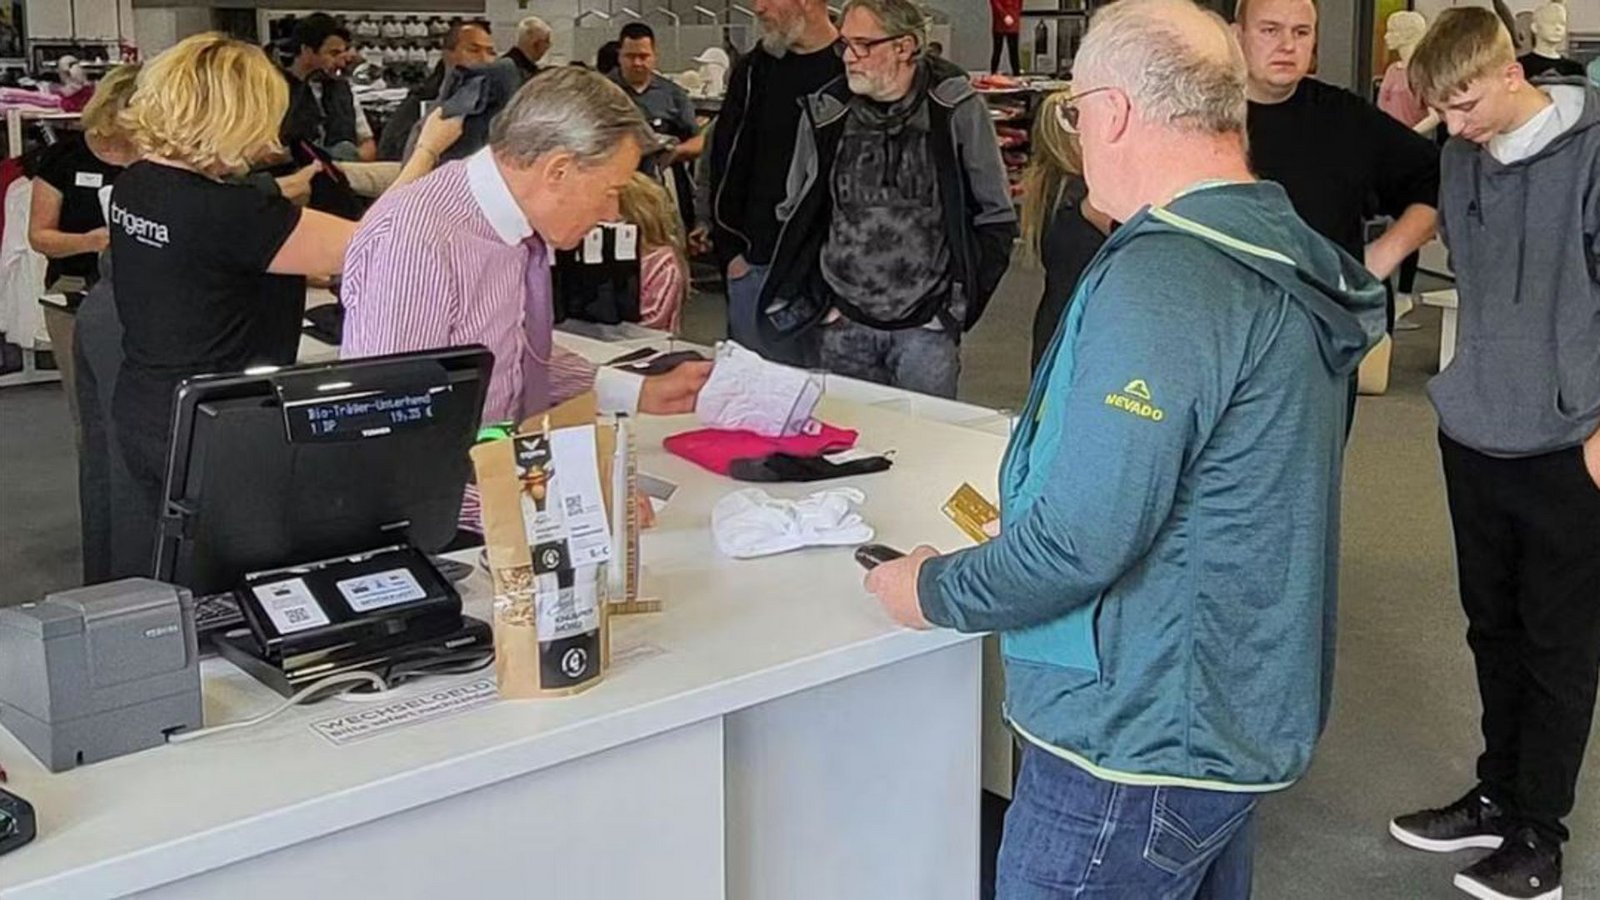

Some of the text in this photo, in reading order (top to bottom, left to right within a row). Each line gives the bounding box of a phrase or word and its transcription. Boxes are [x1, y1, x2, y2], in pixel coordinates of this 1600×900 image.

[111, 201, 169, 243] trigema
[1105, 393, 1163, 421] NEVADO
[319, 678, 491, 730] WECHSELGELD
